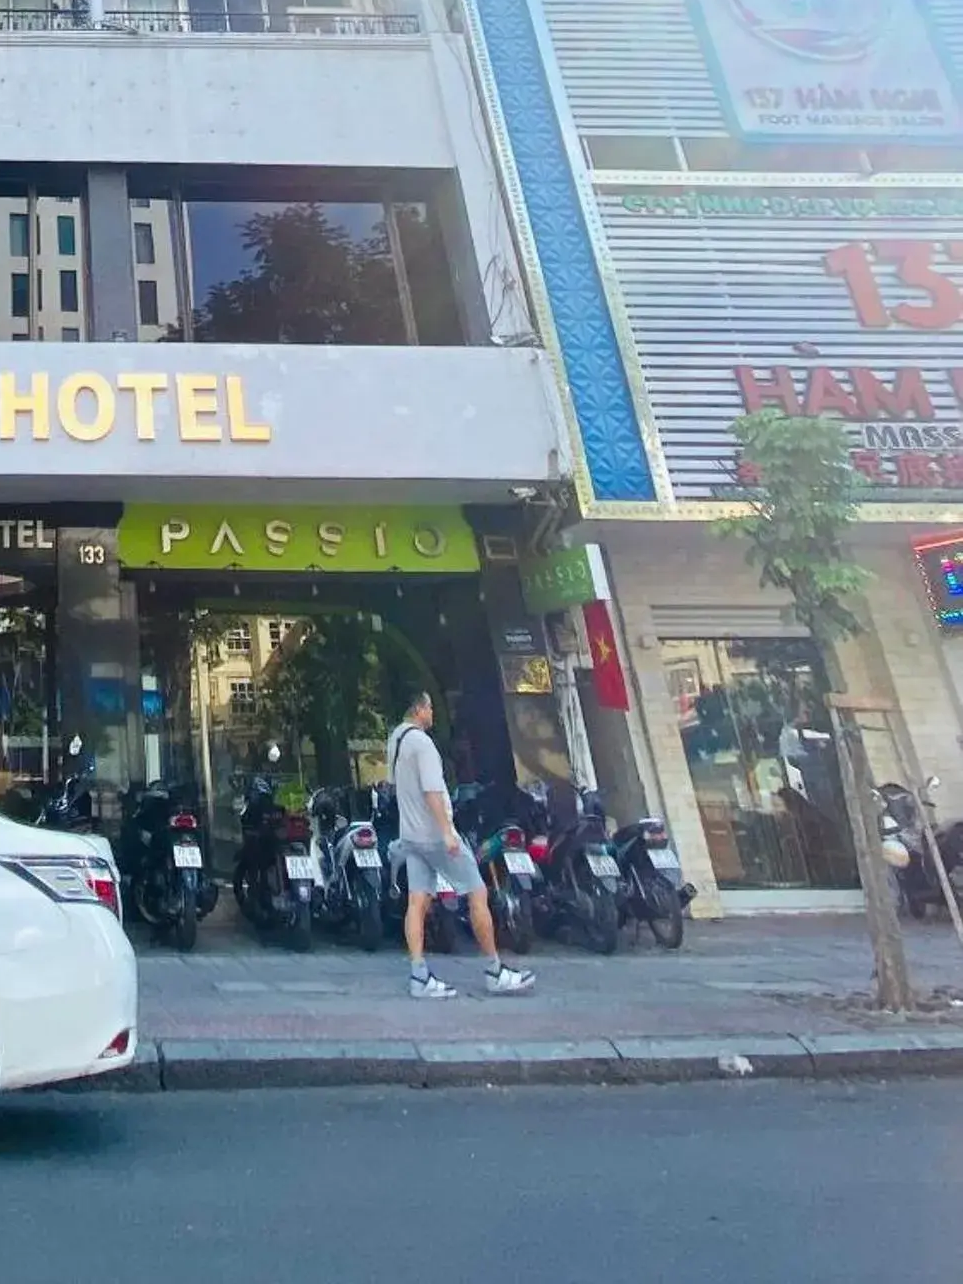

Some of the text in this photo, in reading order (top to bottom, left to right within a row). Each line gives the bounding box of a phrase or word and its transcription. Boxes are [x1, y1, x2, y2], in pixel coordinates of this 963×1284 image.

[823, 240, 963, 328] 13
[78, 544, 106, 565] 133
[160, 518, 449, 558] PASSIO
